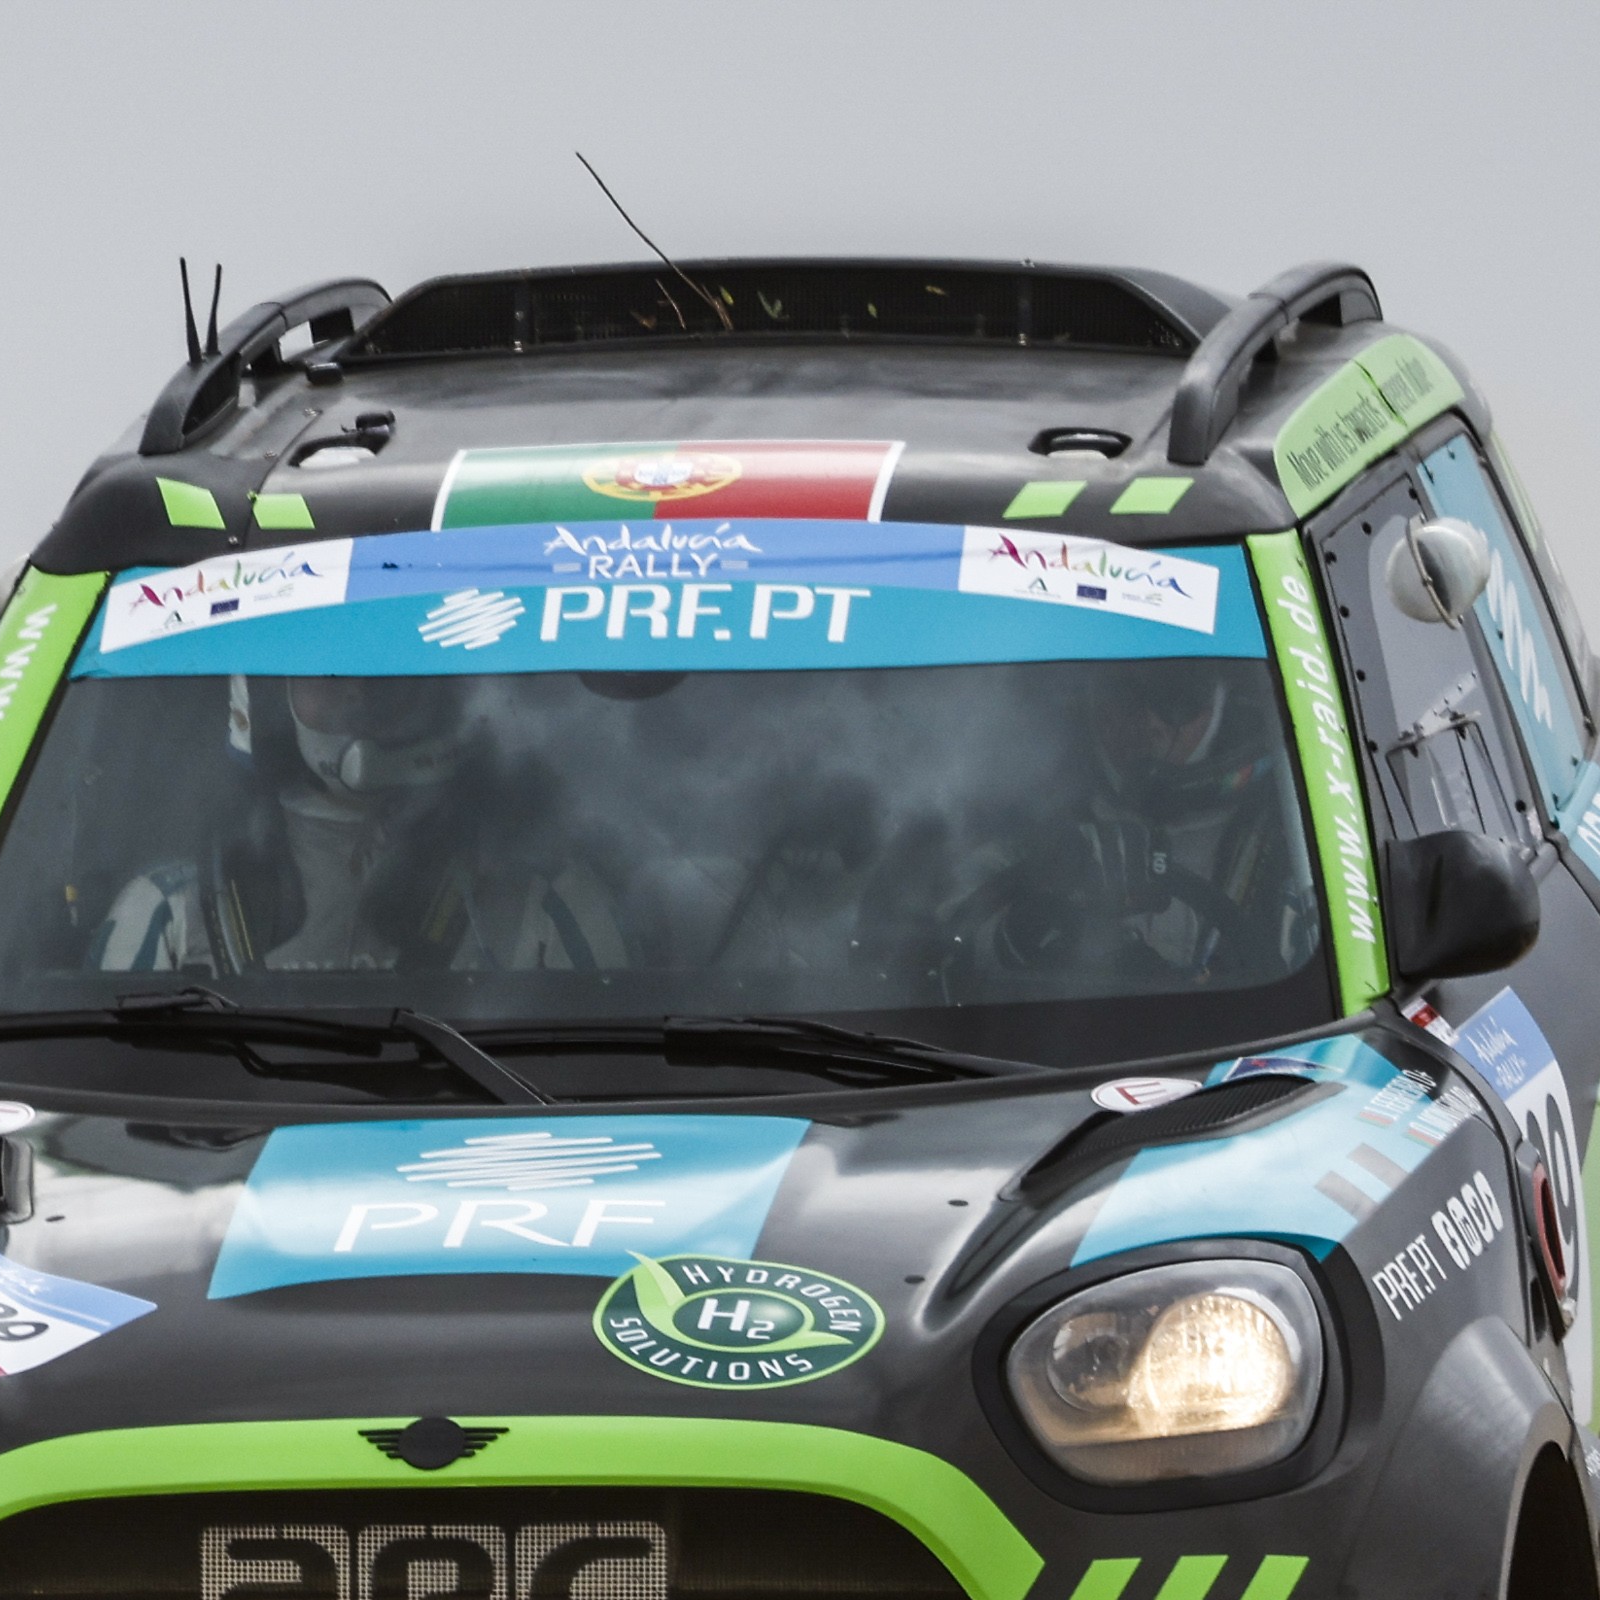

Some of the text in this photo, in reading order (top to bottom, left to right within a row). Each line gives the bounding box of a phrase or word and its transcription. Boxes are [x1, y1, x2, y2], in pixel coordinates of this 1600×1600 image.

[544, 523, 763, 557] Andalucía
[588, 553, 718, 579] RALLY
[989, 533, 1193, 599] Andalucía
[129, 551, 324, 615] Andalucía
[540, 583, 872, 642] PRF.PT
[1277, 574, 1376, 944] www.x-raid.de
[333, 1199, 666, 1252] PRF
[681, 1264, 862, 1333] HYDROGEN
[1371, 1233, 1447, 1321] PRF.PT
[609, 1316, 813, 1380] SOLUTIONS
